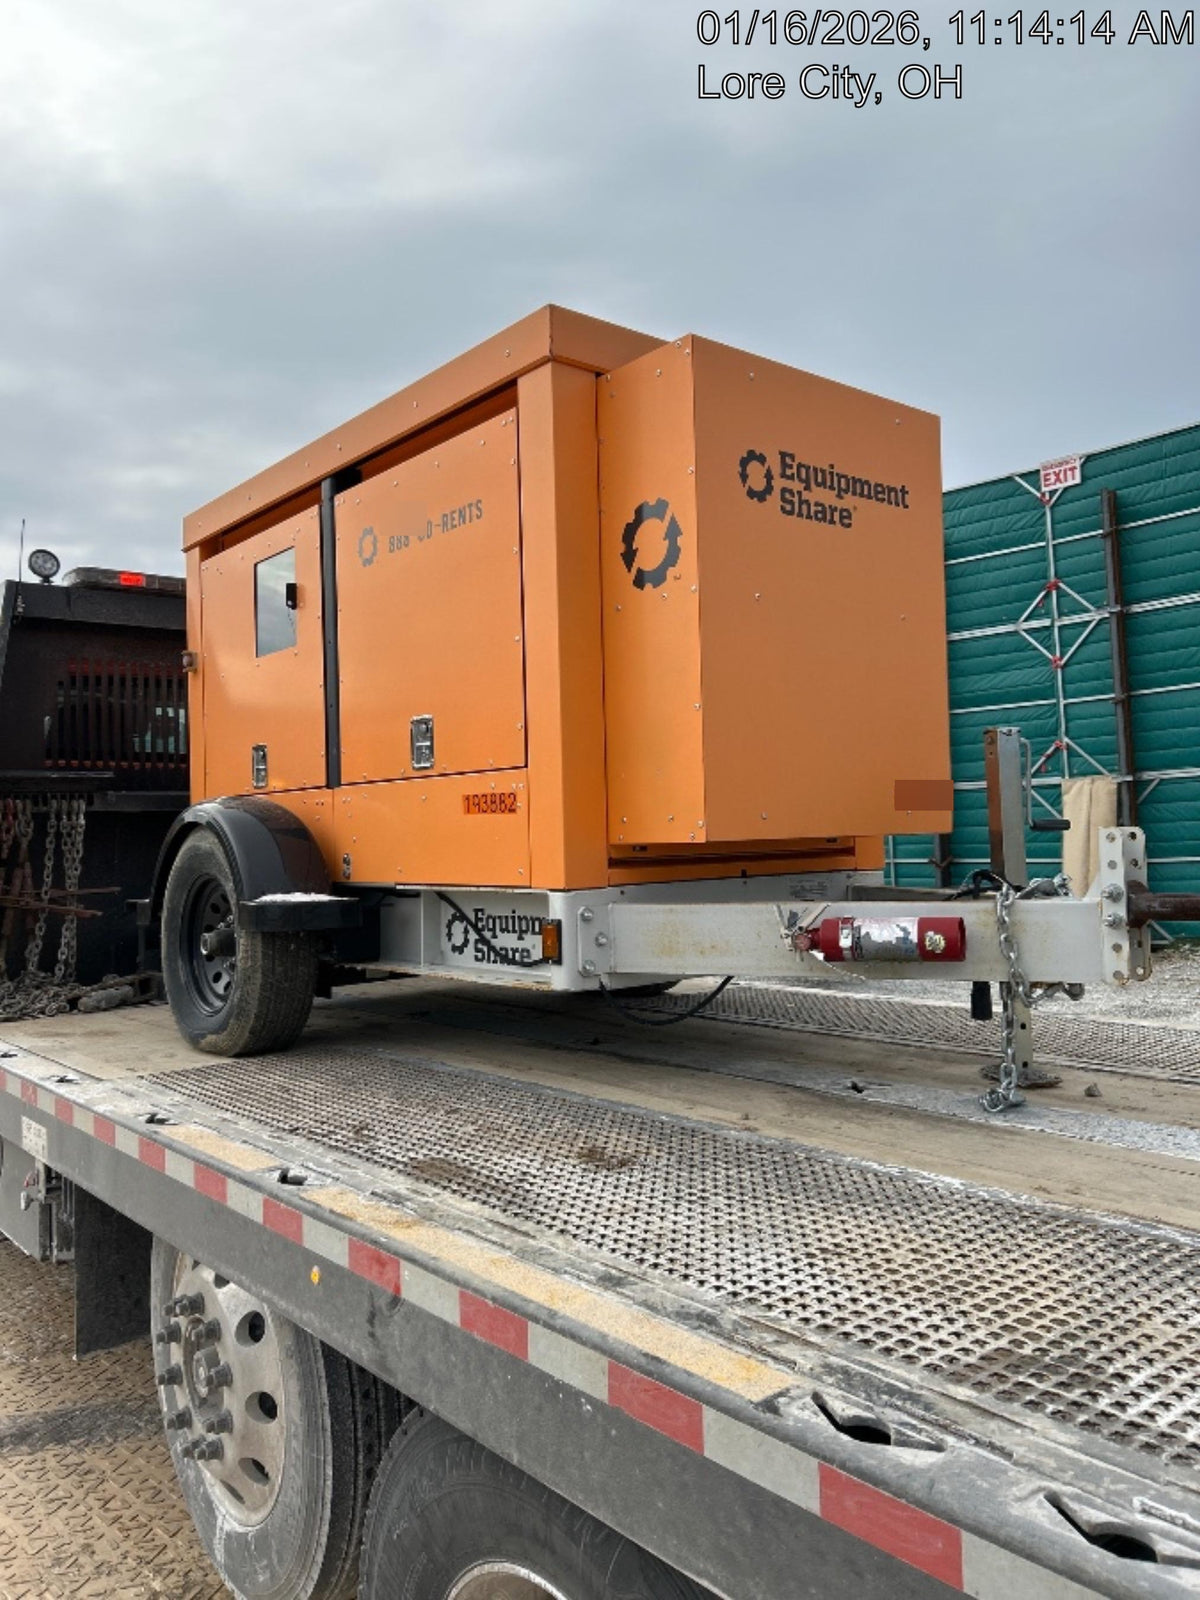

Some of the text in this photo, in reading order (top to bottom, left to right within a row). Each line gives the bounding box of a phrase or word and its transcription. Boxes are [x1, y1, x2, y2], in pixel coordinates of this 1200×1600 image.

[779, 450, 910, 509] Equipment
[1043, 466, 1078, 488] EXIT
[417, 499, 483, 542] O-RENTS
